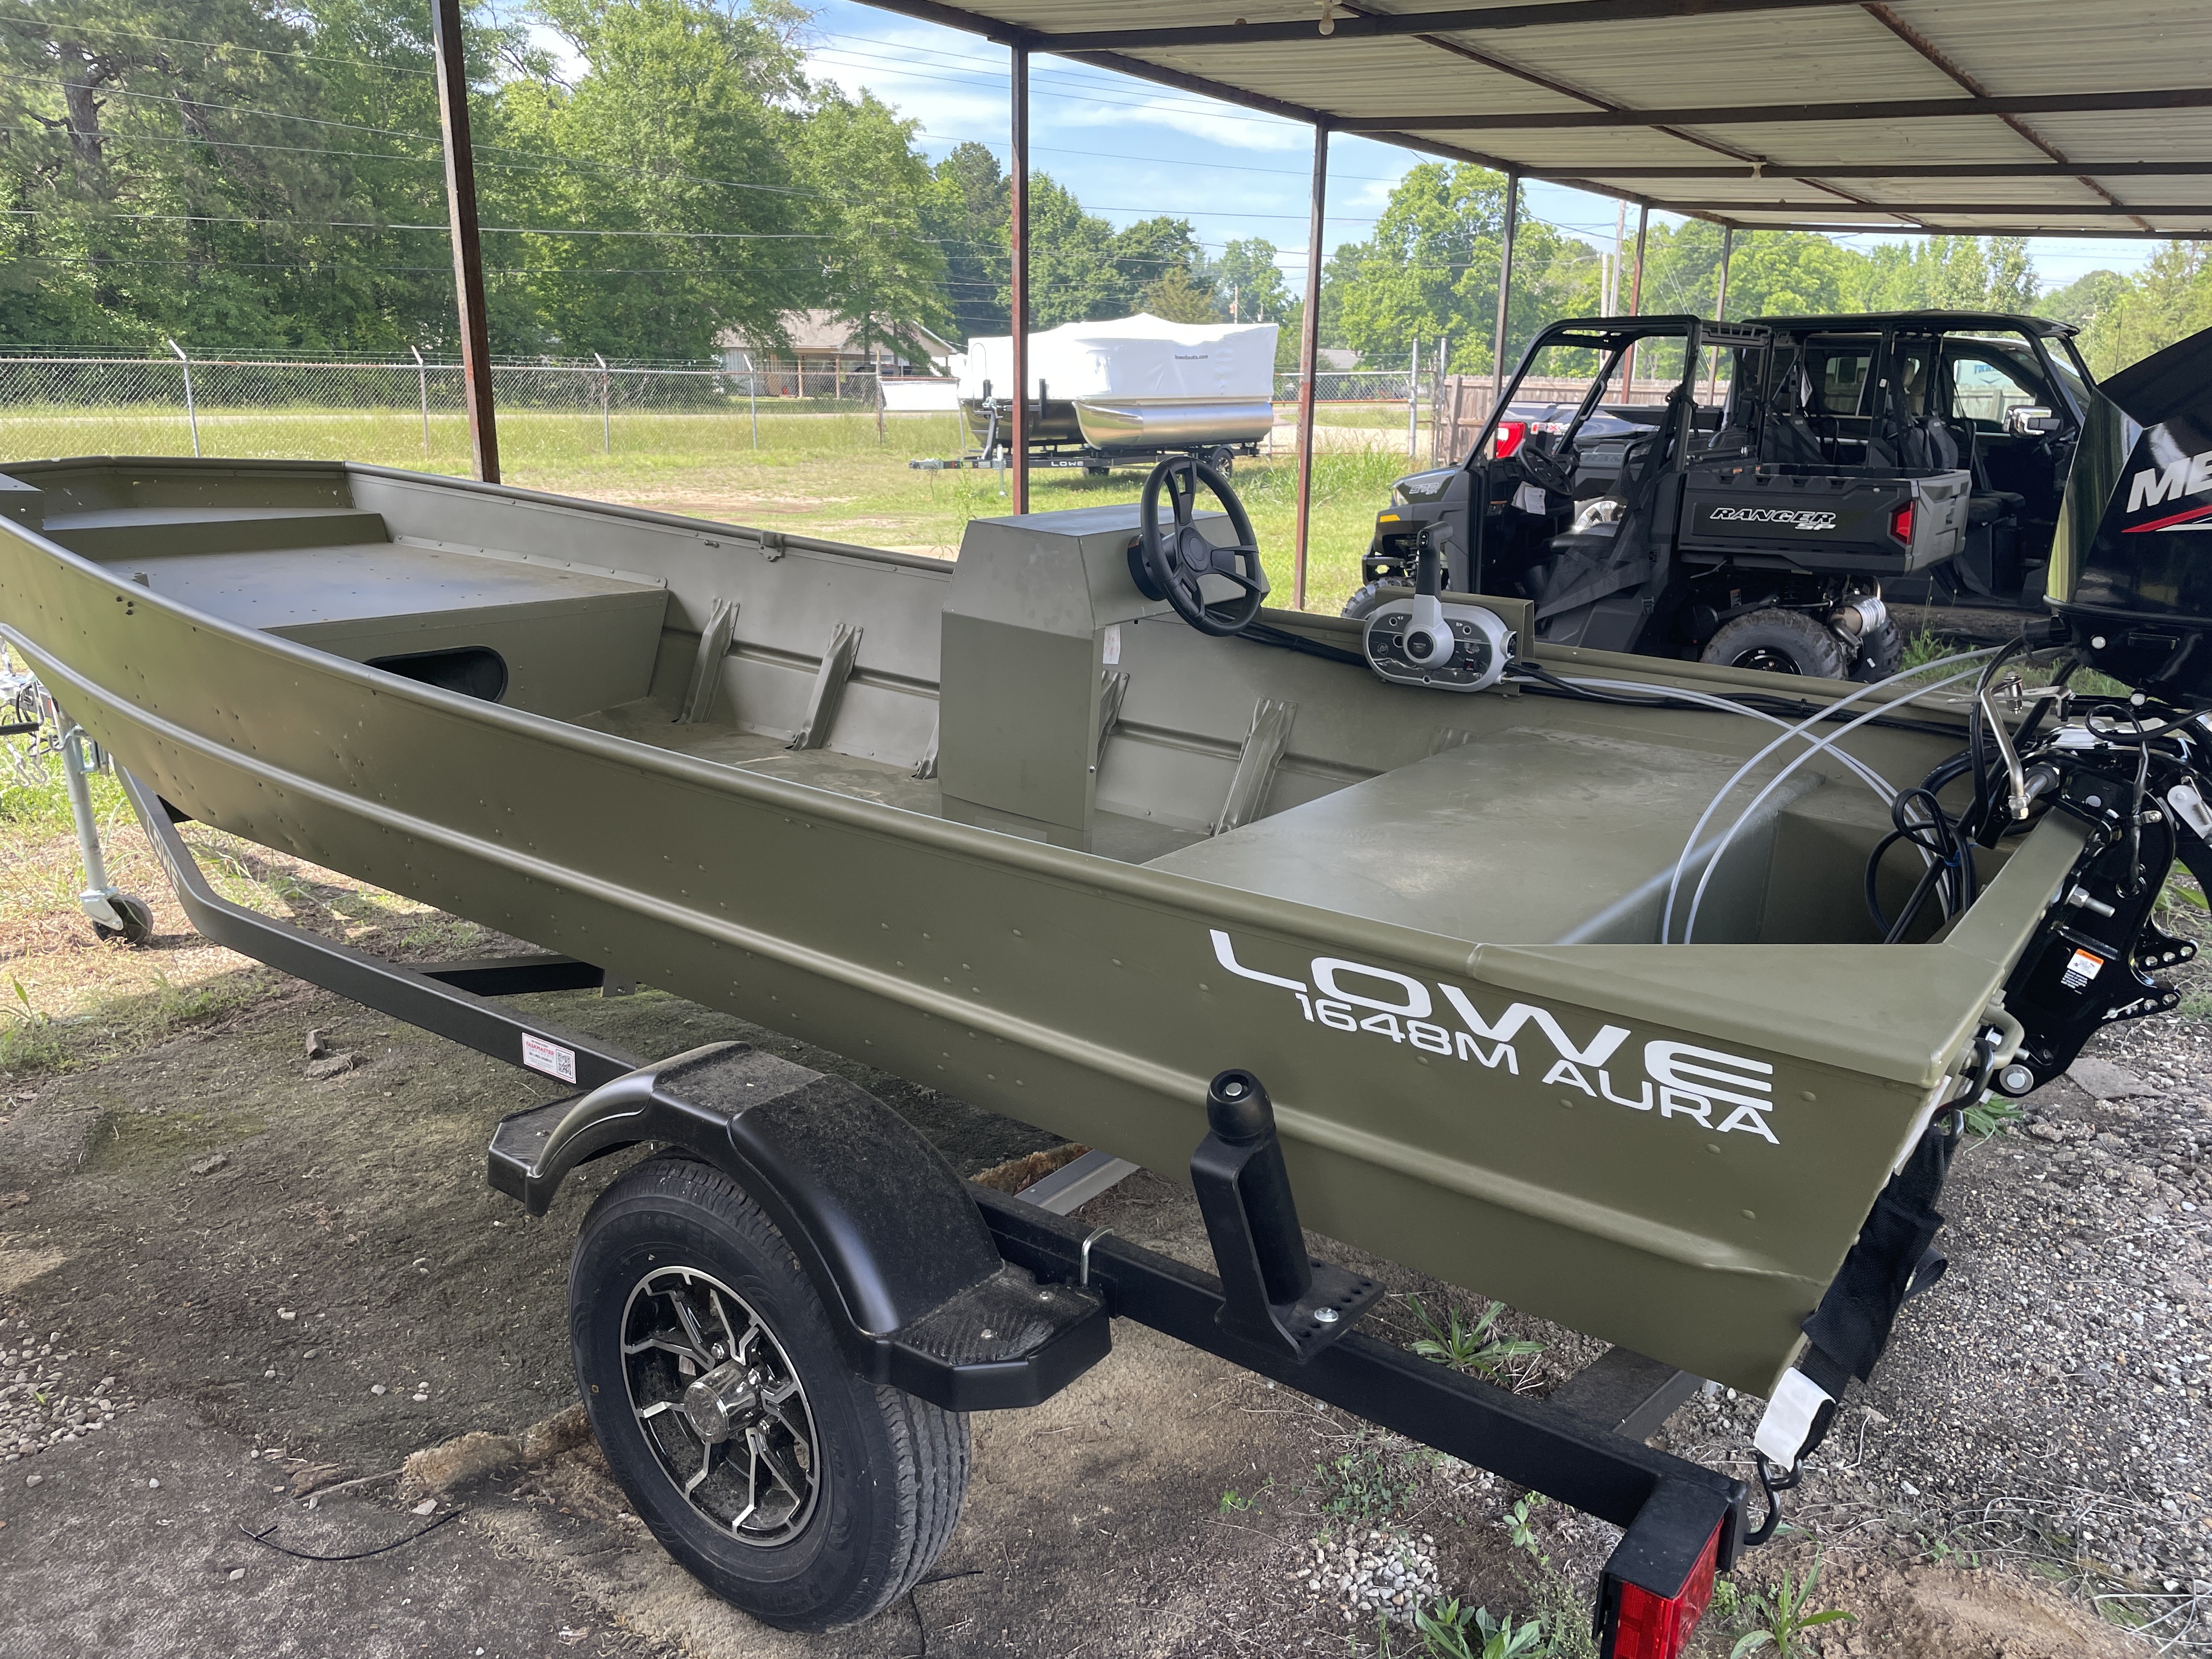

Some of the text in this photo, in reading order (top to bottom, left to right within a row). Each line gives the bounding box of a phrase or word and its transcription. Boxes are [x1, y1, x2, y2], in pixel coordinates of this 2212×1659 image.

[1409, 482, 1439, 494] 570
[1710, 507, 1836, 524] RANGER
[146, 816, 180, 897] LOWE
[1209, 929, 1773, 1111] LOWE
[526, 1041, 555, 1056] TASKMASTER
[1295, 992, 1780, 1144] 1648M AURA
